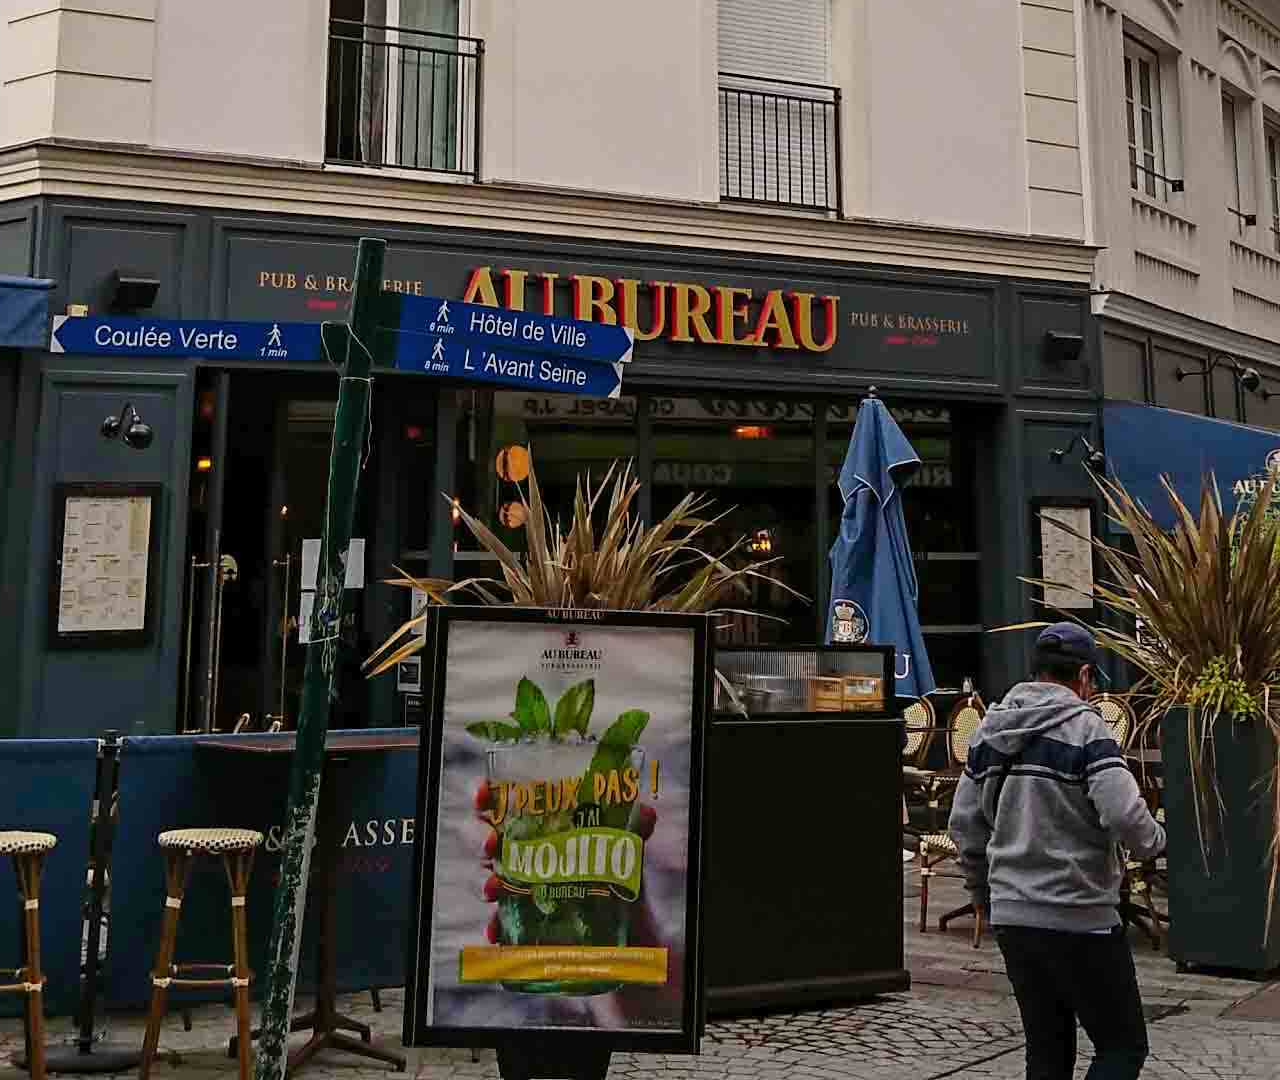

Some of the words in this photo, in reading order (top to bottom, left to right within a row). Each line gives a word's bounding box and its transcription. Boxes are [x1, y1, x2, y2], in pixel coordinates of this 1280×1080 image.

[258, 271, 297, 289] PUB
[304, 274, 319, 290] &
[571, 273, 840, 352] BUREAU
[848, 311, 880, 328] PUB
[95, 324, 172, 348] Coulée
[179, 327, 238, 350] Verte
[436, 323, 455, 335] min
[470, 311, 518, 337] Hôtel
[522, 320, 544, 341] de
[551, 322, 587, 348] Ville
[272, 347, 288, 358] min
[431, 361, 449, 372] min
[539, 361, 587, 386] Seine
[1232, 479, 1256, 494] AU
[592, 767, 640, 806] PAS
[508, 834, 636, 880] MOJITO
